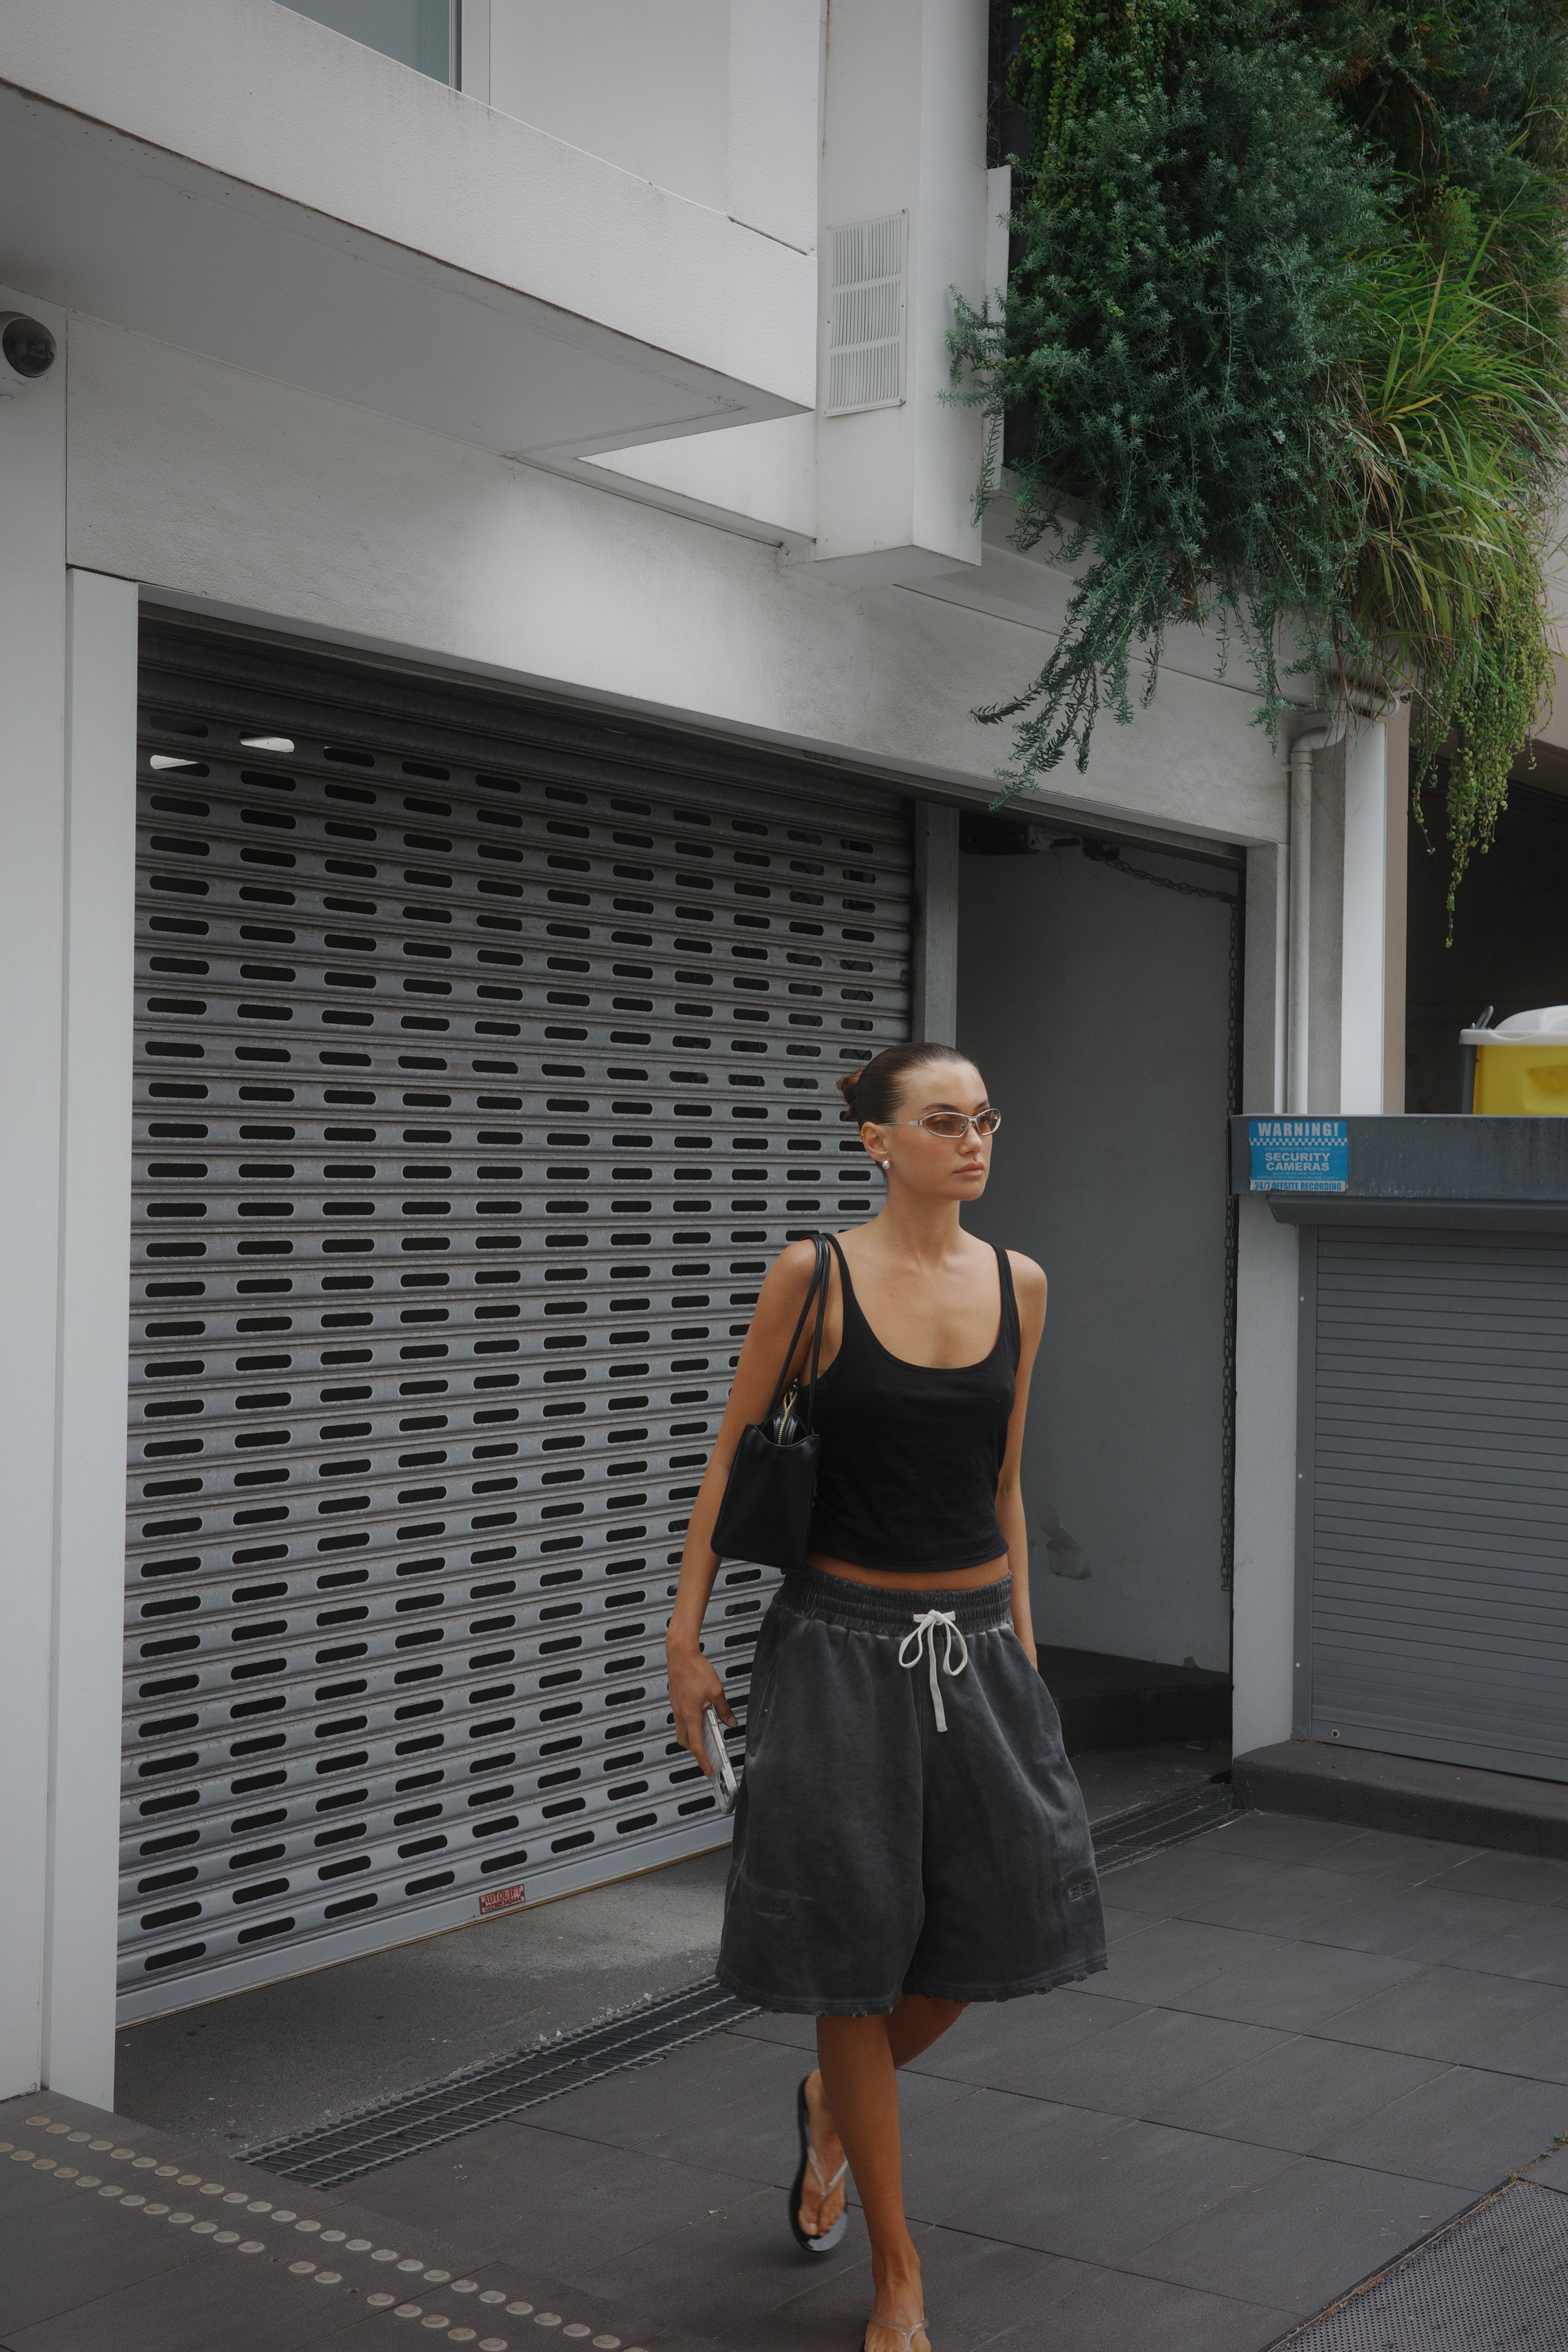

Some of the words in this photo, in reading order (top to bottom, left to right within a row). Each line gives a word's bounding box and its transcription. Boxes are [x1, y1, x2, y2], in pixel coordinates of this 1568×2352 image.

[1258, 1122, 1339, 1136] WARNING!
[1265, 1152, 1331, 1161] SECURITY
[1266, 1162, 1330, 1171] CAMERAS
[1254, 1182, 1271, 1190] 24/7
[1300, 1182, 1342, 1191] RECORDING
[485, 1886, 521, 1904] AUTOLIFT
